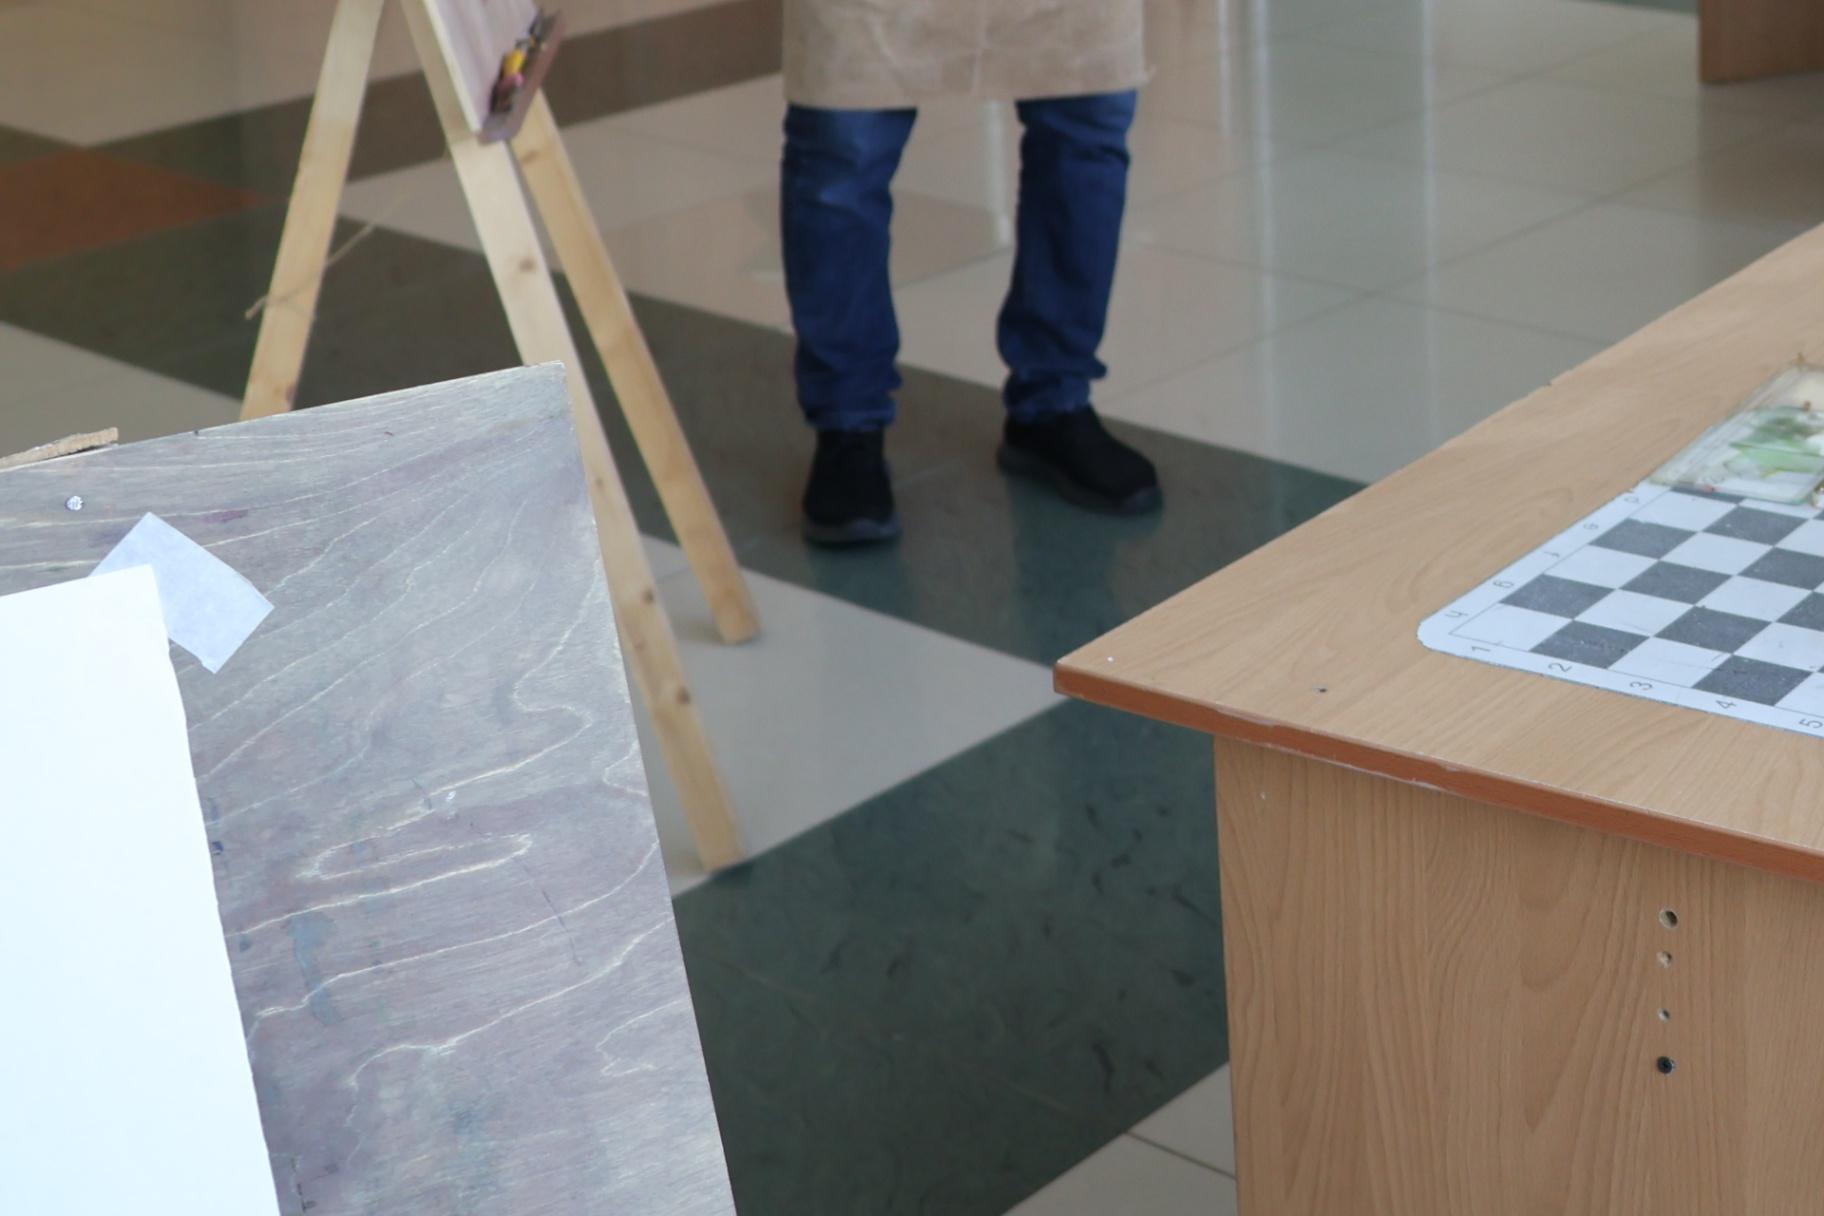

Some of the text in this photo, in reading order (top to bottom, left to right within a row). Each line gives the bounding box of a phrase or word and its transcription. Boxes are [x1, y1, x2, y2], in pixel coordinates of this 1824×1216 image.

[1471, 644, 1490, 653] 1
[1548, 662, 1572, 672] 2
[1630, 680, 1653, 691] 3
[1716, 699, 1736, 709] 4
[1799, 717, 1823, 729] 5
